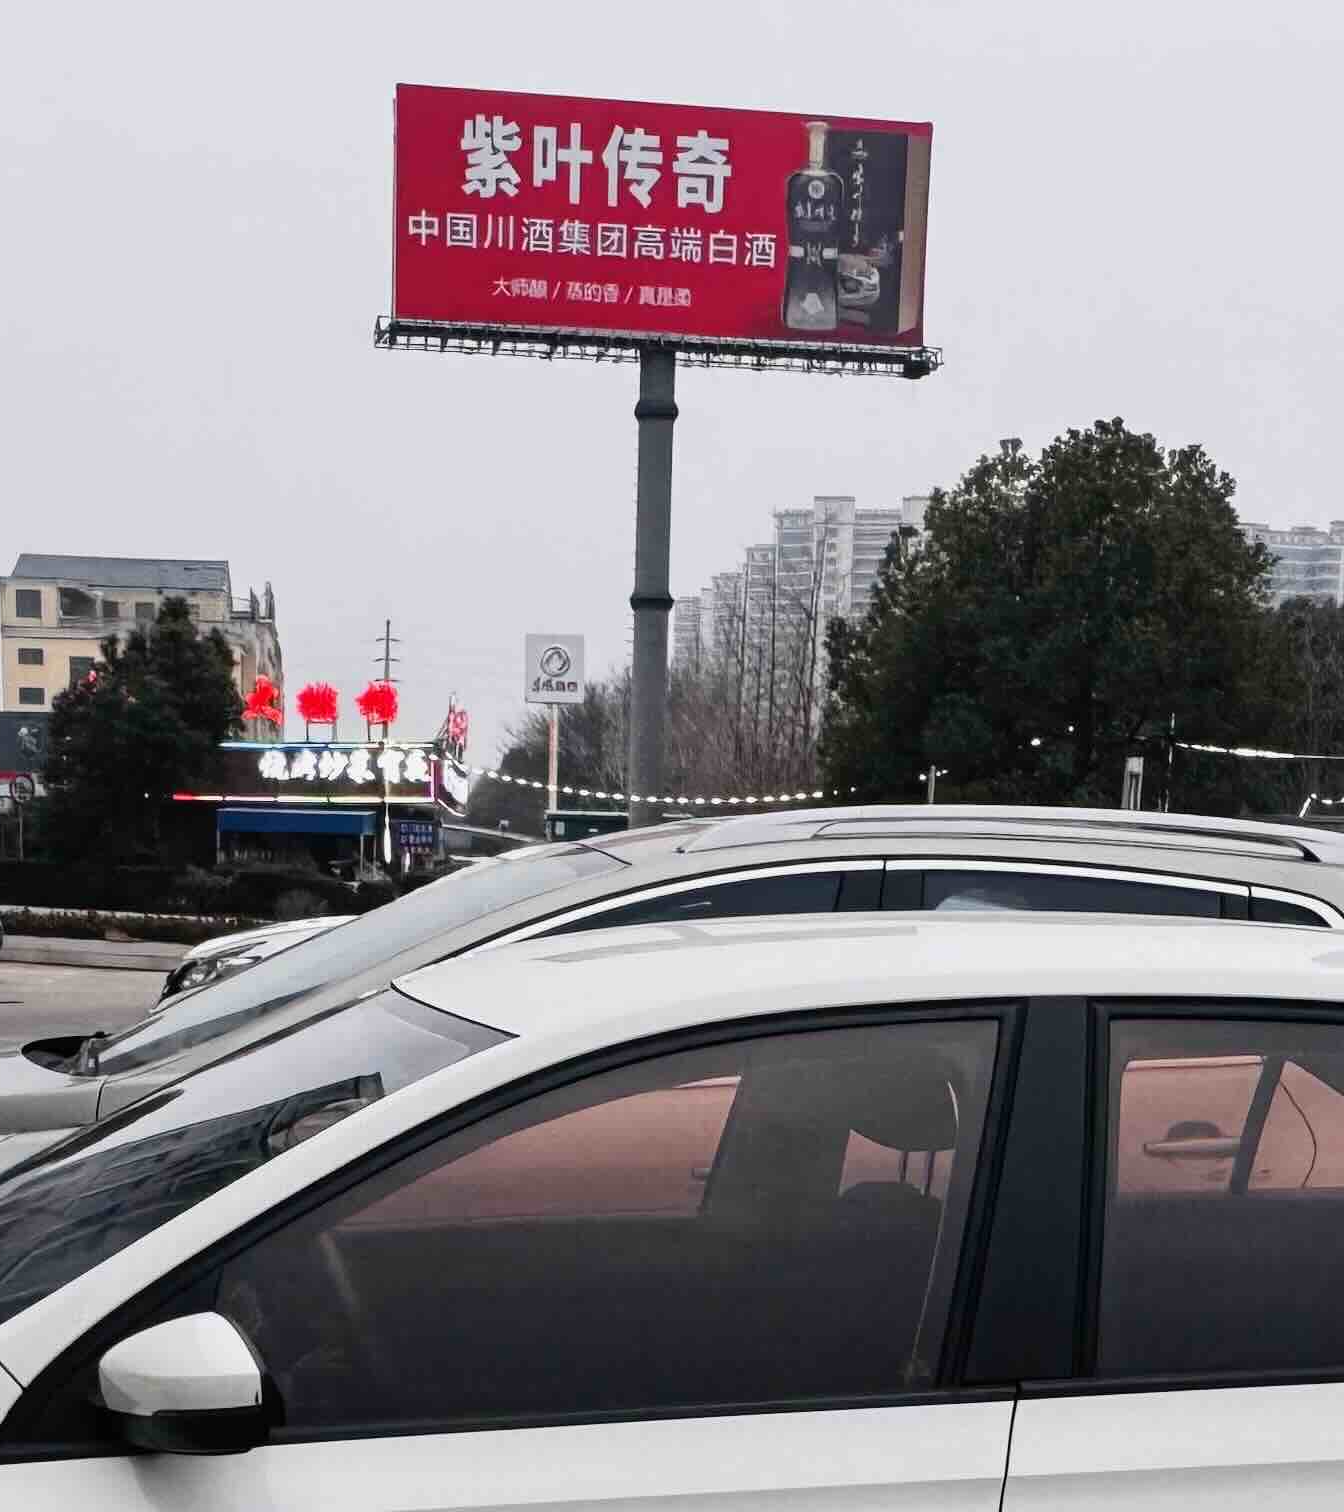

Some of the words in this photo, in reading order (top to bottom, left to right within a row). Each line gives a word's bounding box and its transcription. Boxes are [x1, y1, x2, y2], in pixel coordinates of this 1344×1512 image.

[460, 113, 732, 214] 紫叶传奇
[408, 207, 777, 269] 中国川酒集团高端白酒
